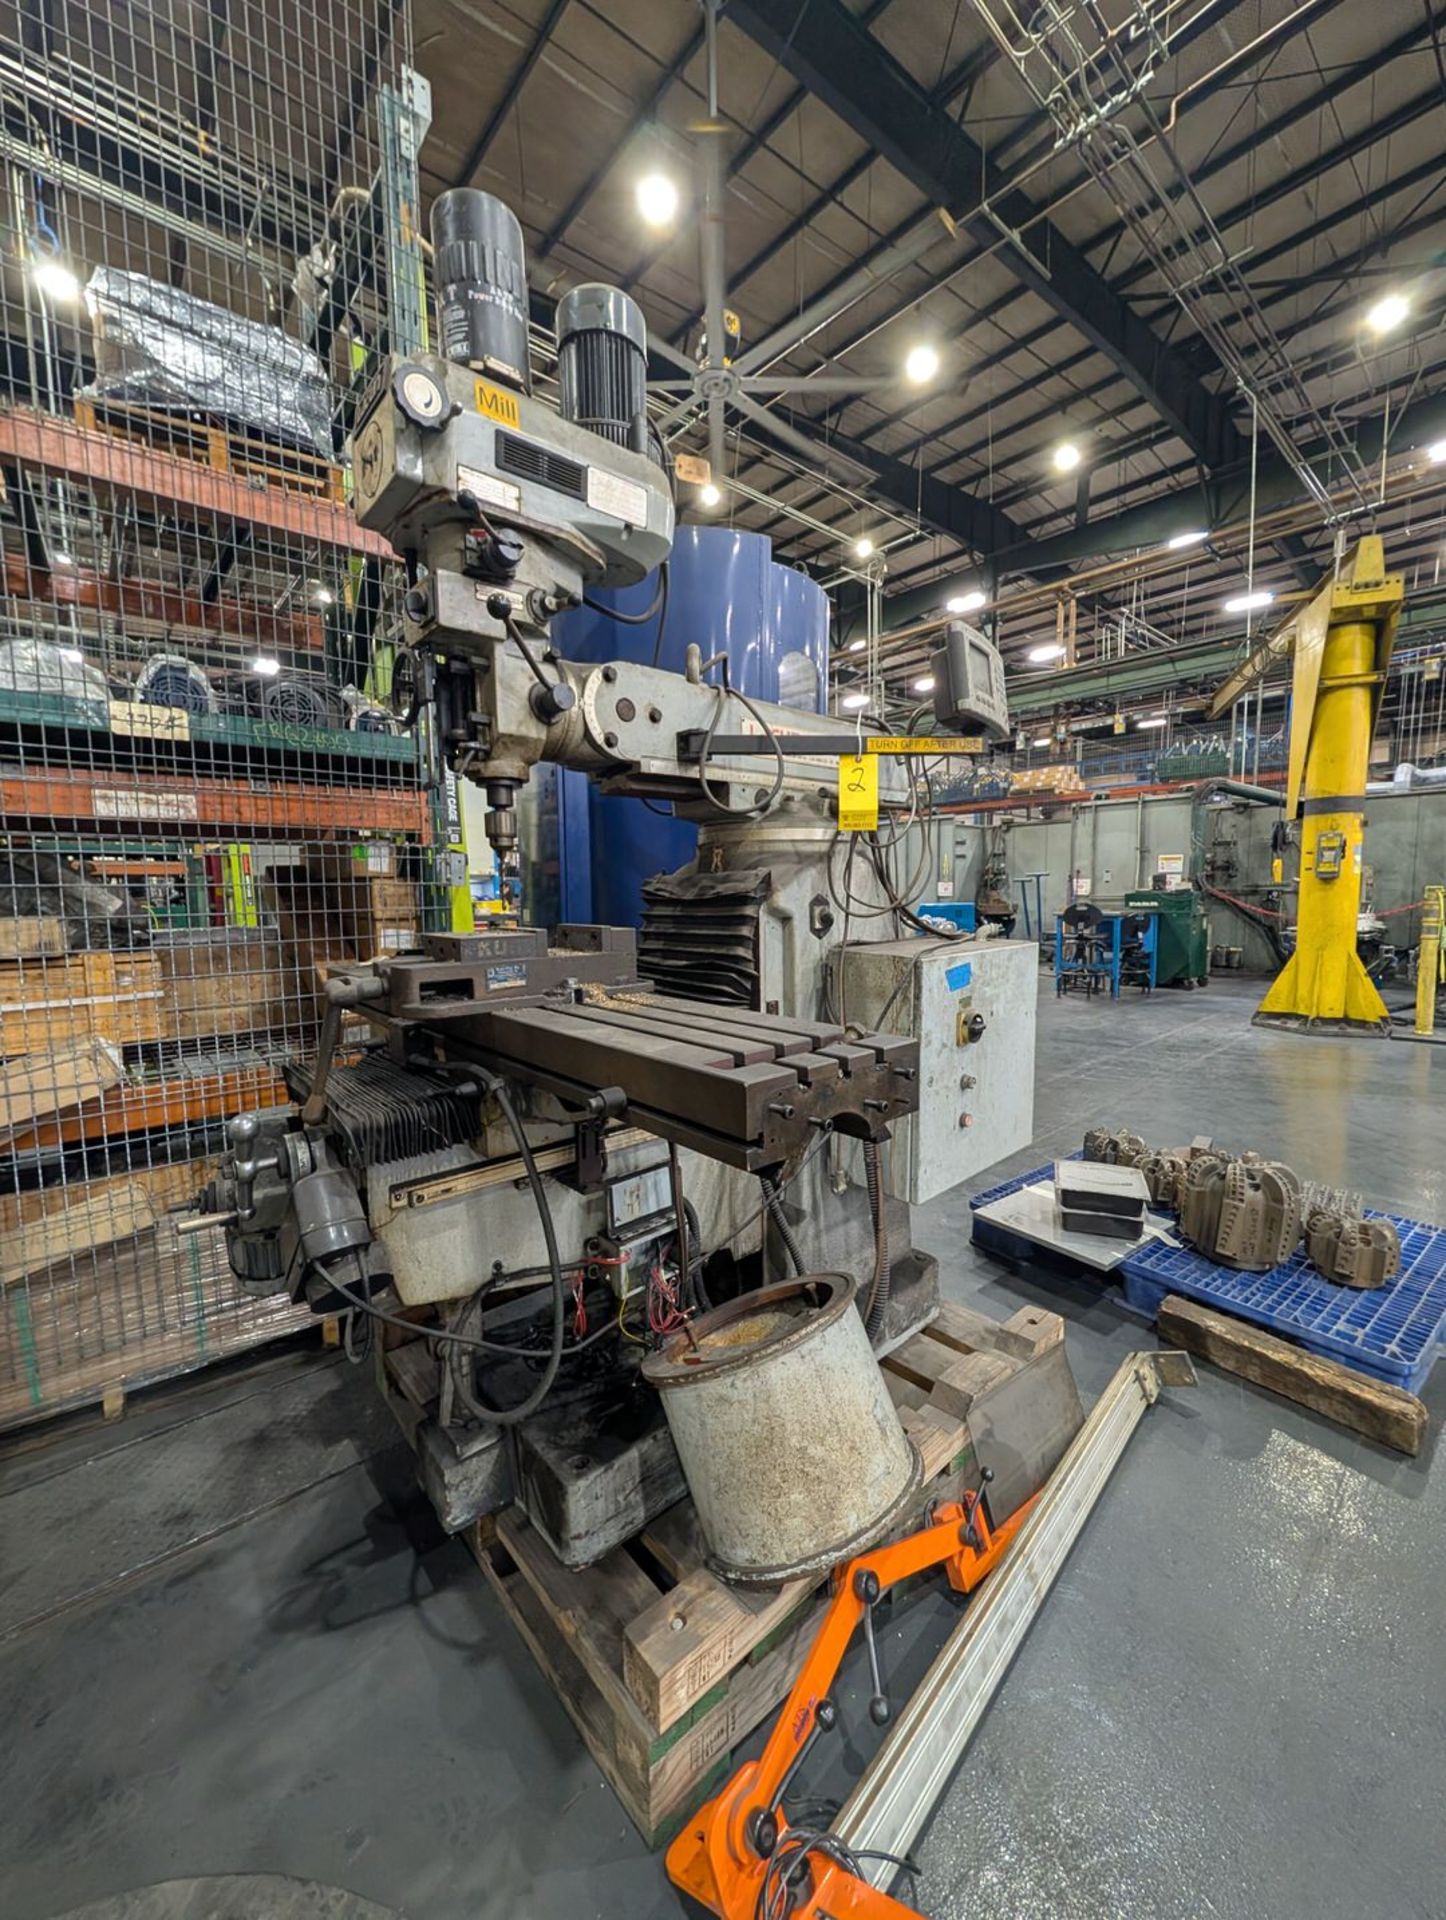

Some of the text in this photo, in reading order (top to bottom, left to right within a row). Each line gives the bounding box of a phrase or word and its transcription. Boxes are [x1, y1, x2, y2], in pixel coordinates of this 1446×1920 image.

[479, 386, 516, 421] Mill
[870, 739, 981, 750] TURN OFF AFTER USE
[847, 767, 866, 792] 2
